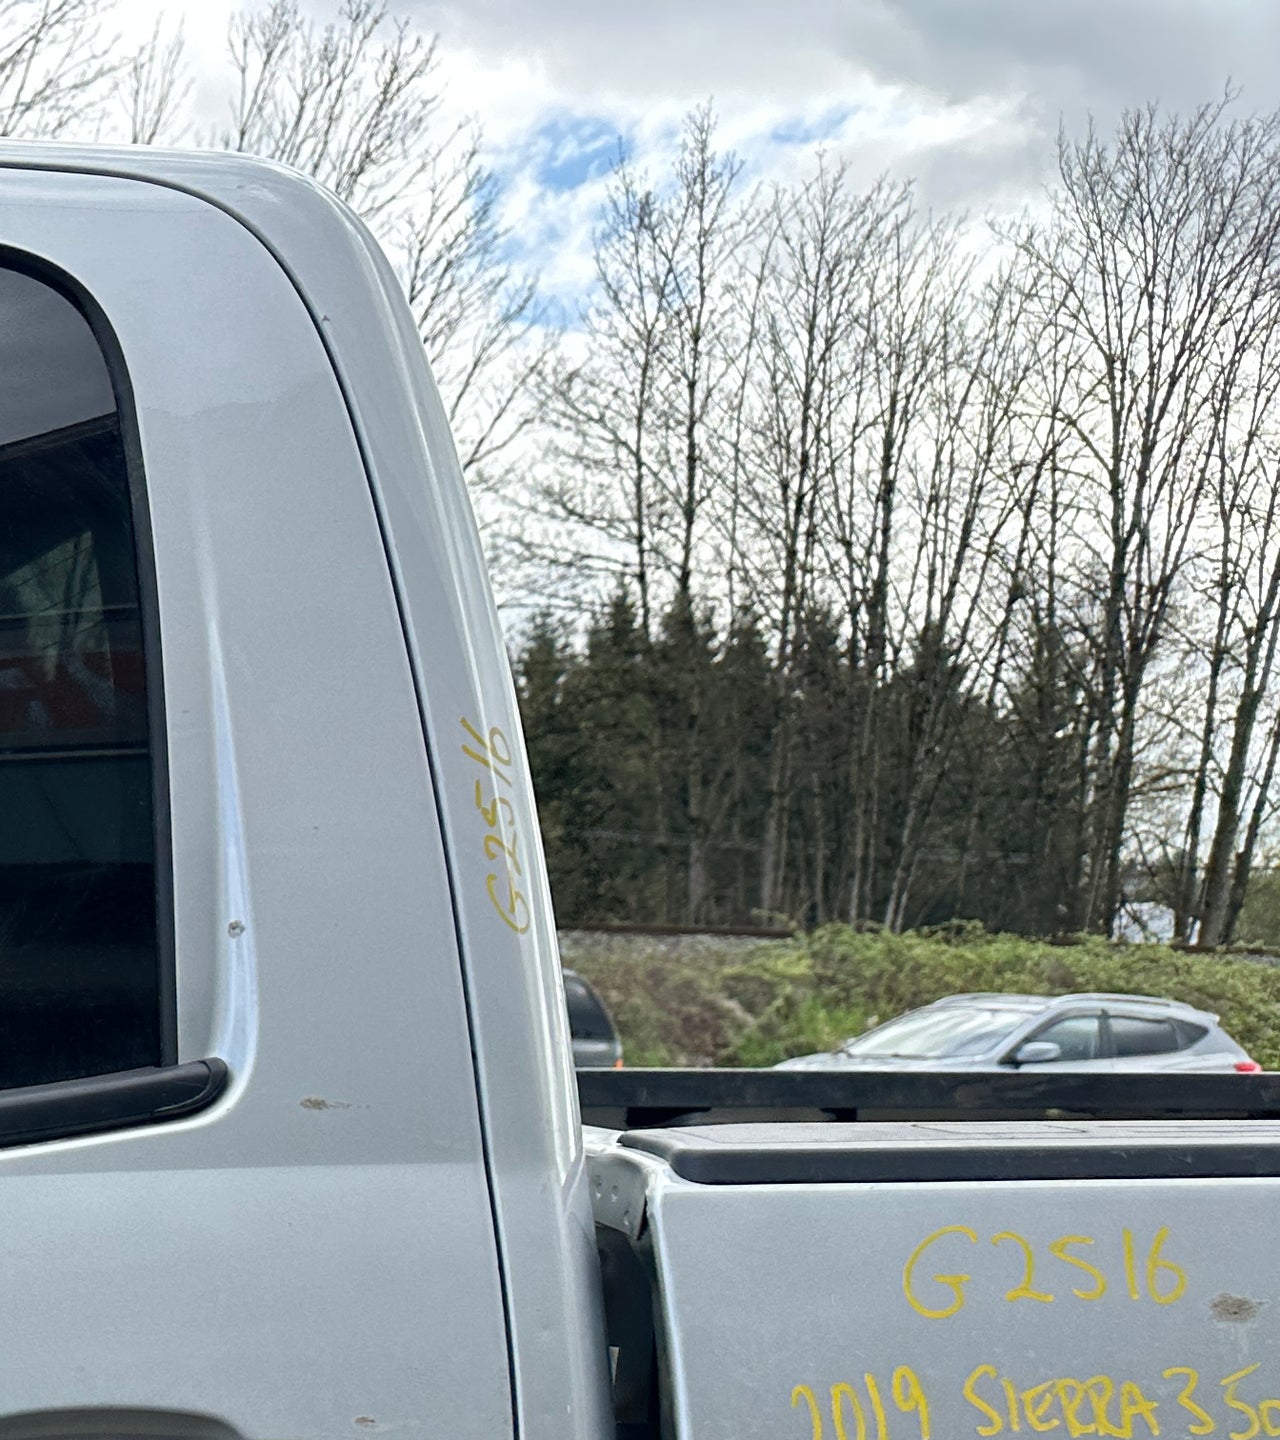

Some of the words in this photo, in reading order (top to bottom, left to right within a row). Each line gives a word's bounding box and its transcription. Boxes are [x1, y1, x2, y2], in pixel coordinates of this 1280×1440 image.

[460, 716, 530, 934] G2516
[902, 1224, 1188, 1319] G2516
[962, 1364, 1160, 1439] SIERRA
